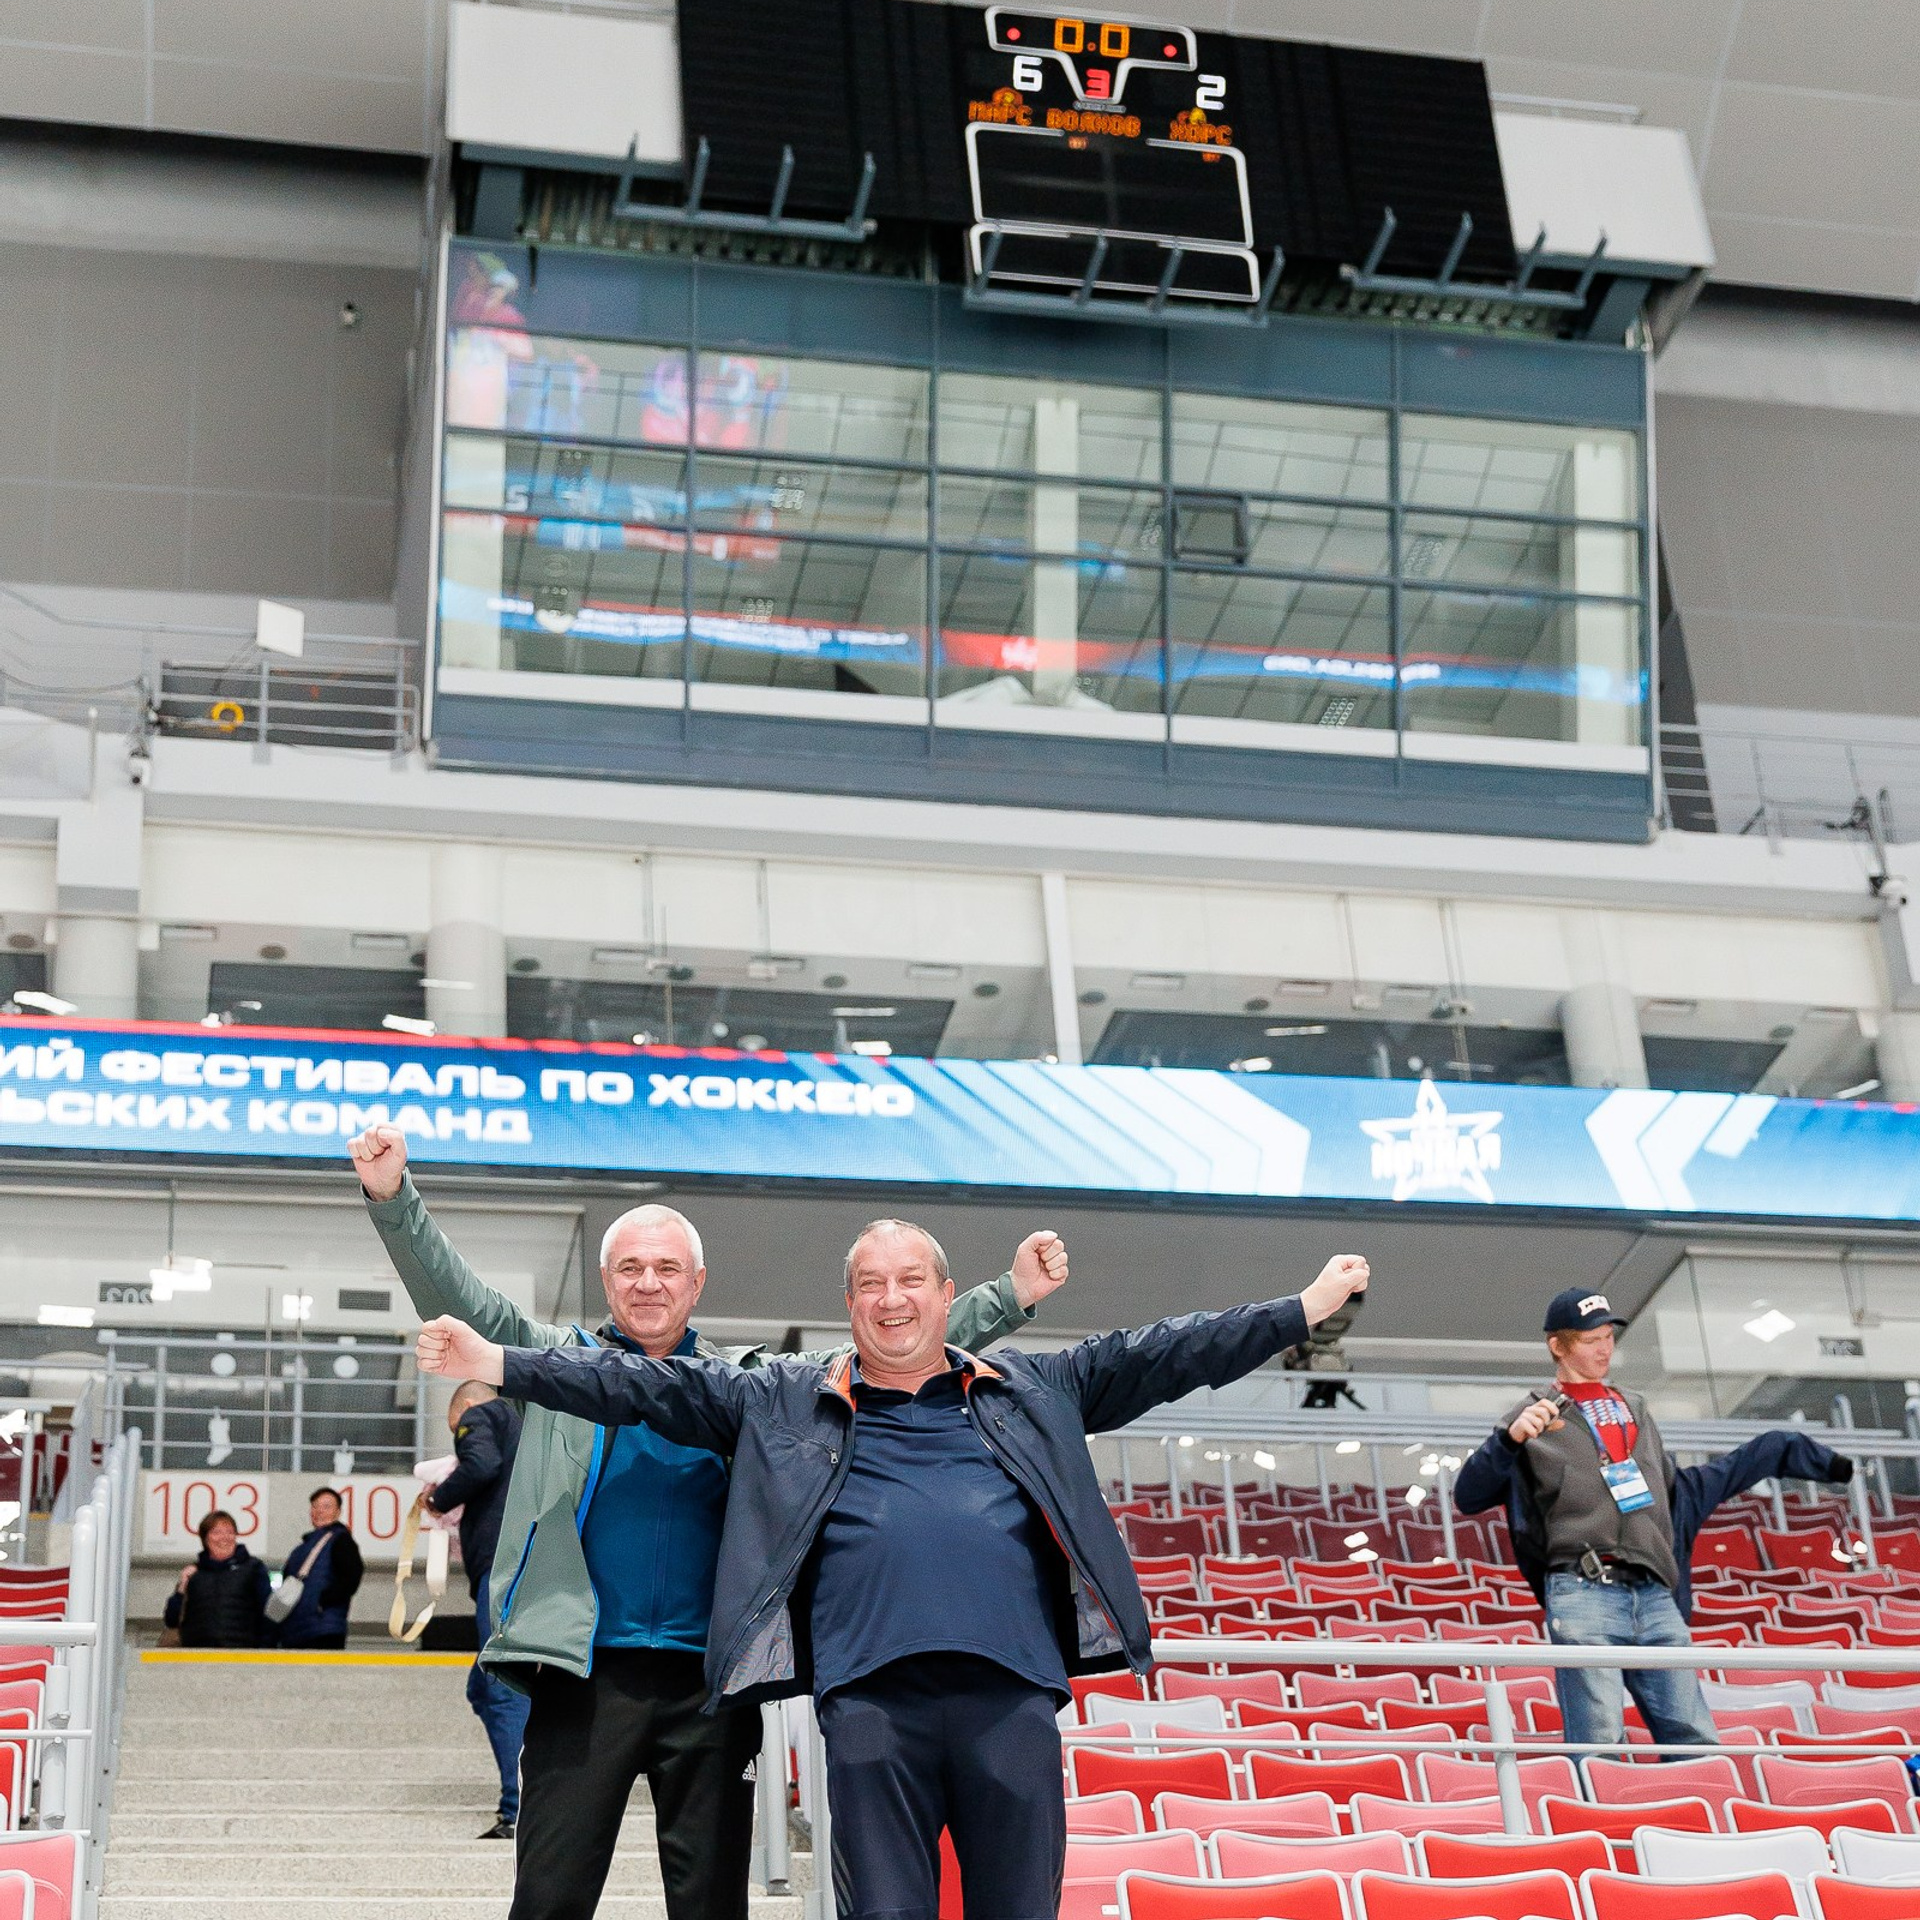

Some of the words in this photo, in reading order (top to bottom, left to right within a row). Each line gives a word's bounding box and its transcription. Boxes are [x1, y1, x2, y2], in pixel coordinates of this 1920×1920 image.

[1054, 17, 1130, 58] 0.0
[1013, 55, 1043, 92] 6
[1085, 69, 1111, 99] 3
[1196, 74, 1227, 110] 2
[99, 1050, 527, 1099] ФЕСТИВАЛЬ
[540, 1069, 634, 1104] ПО
[648, 1073, 916, 1117] ХОККЕЮ
[0, 1087, 232, 1132] ЬСКИХ
[248, 1098, 532, 1144] КОМАНД
[153, 1481, 259, 1537] 103
[338, 1485, 437, 1540] 10
